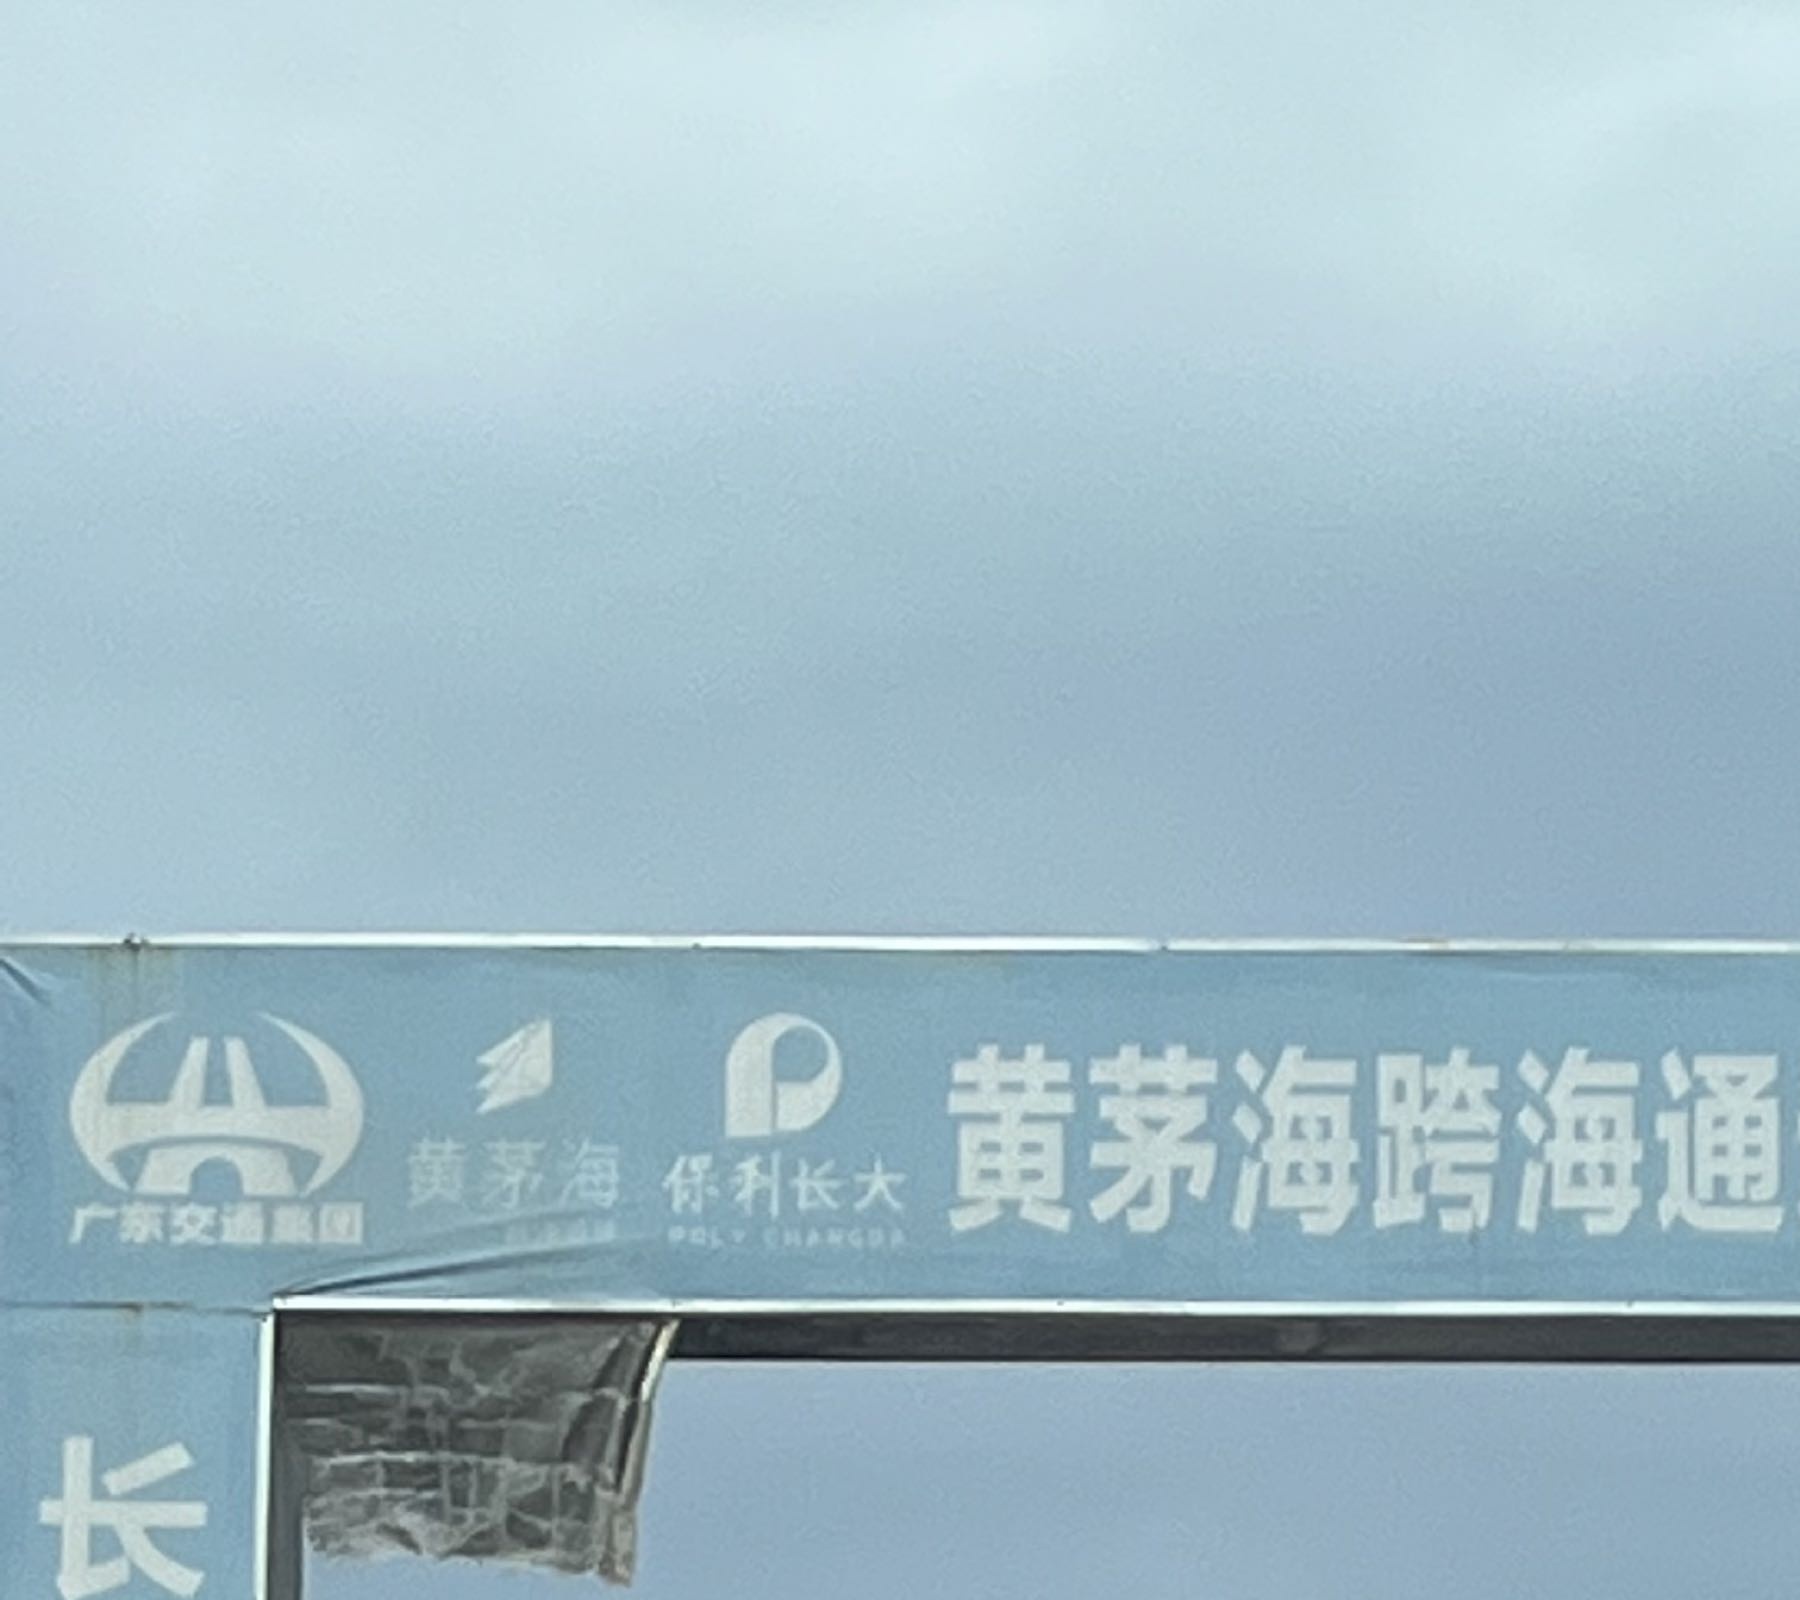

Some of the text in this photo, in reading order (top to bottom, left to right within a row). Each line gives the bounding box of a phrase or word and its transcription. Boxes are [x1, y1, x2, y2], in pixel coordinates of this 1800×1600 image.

[406, 1136, 620, 1210] 黄茅海
[662, 1150, 907, 1220] 保利长大
